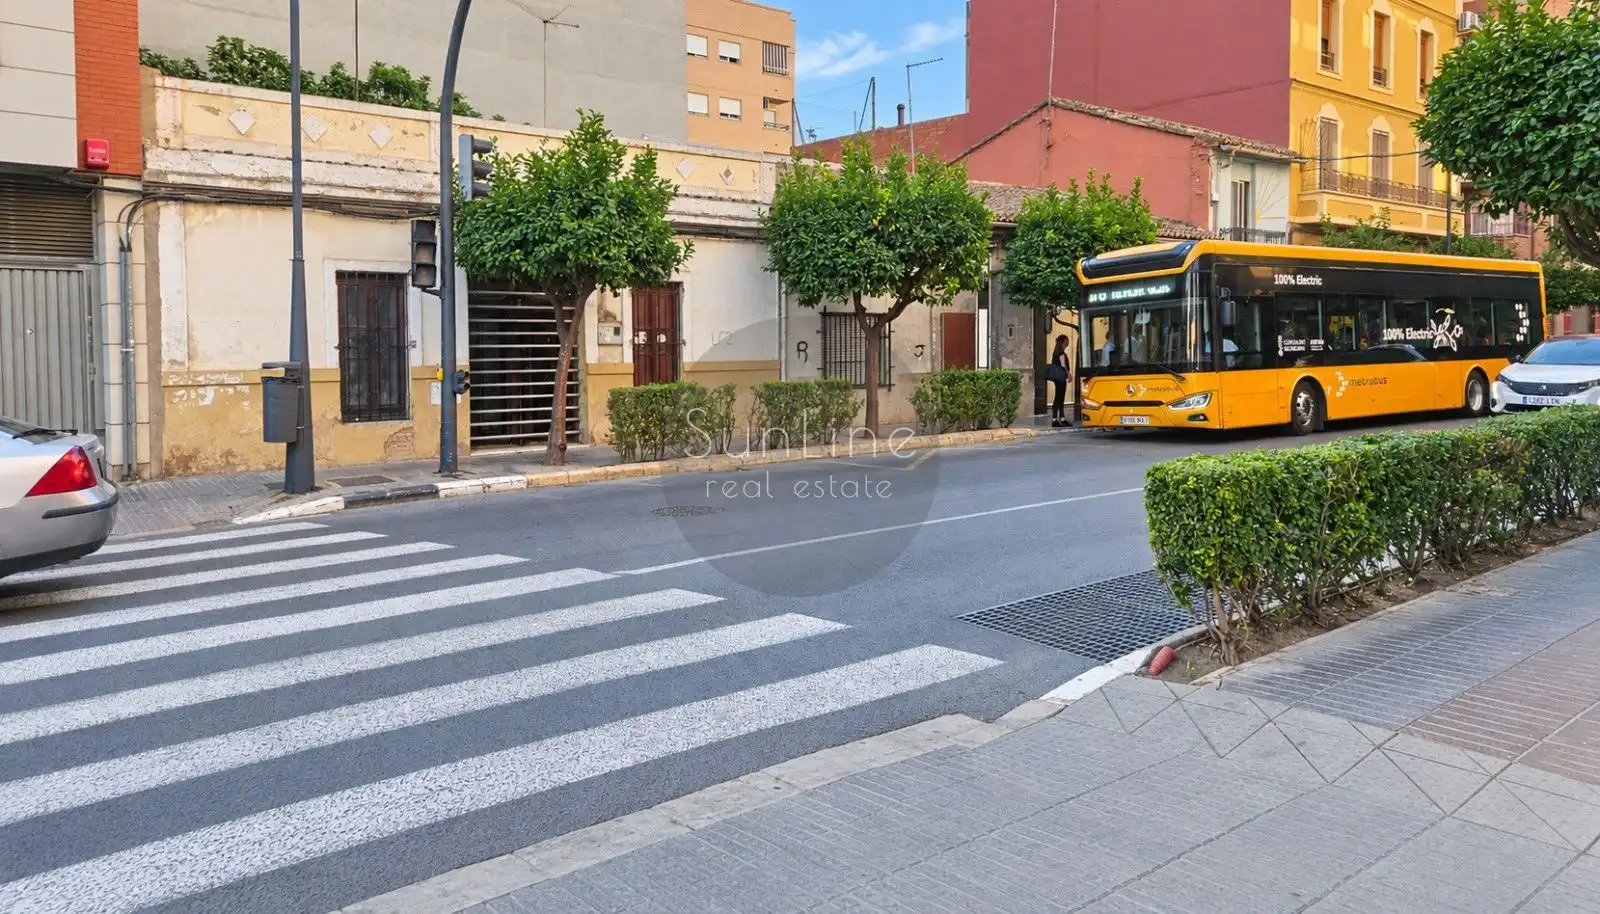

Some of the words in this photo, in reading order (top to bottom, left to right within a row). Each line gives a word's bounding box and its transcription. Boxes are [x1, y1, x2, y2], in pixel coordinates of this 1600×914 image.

[1273, 274, 1295, 285] 100%
[1296, 274, 1323, 286] Electric
[1383, 328, 1404, 340] 100%
[1405, 327, 1434, 340] Electric
[1350, 376, 1388, 386] metrobus
